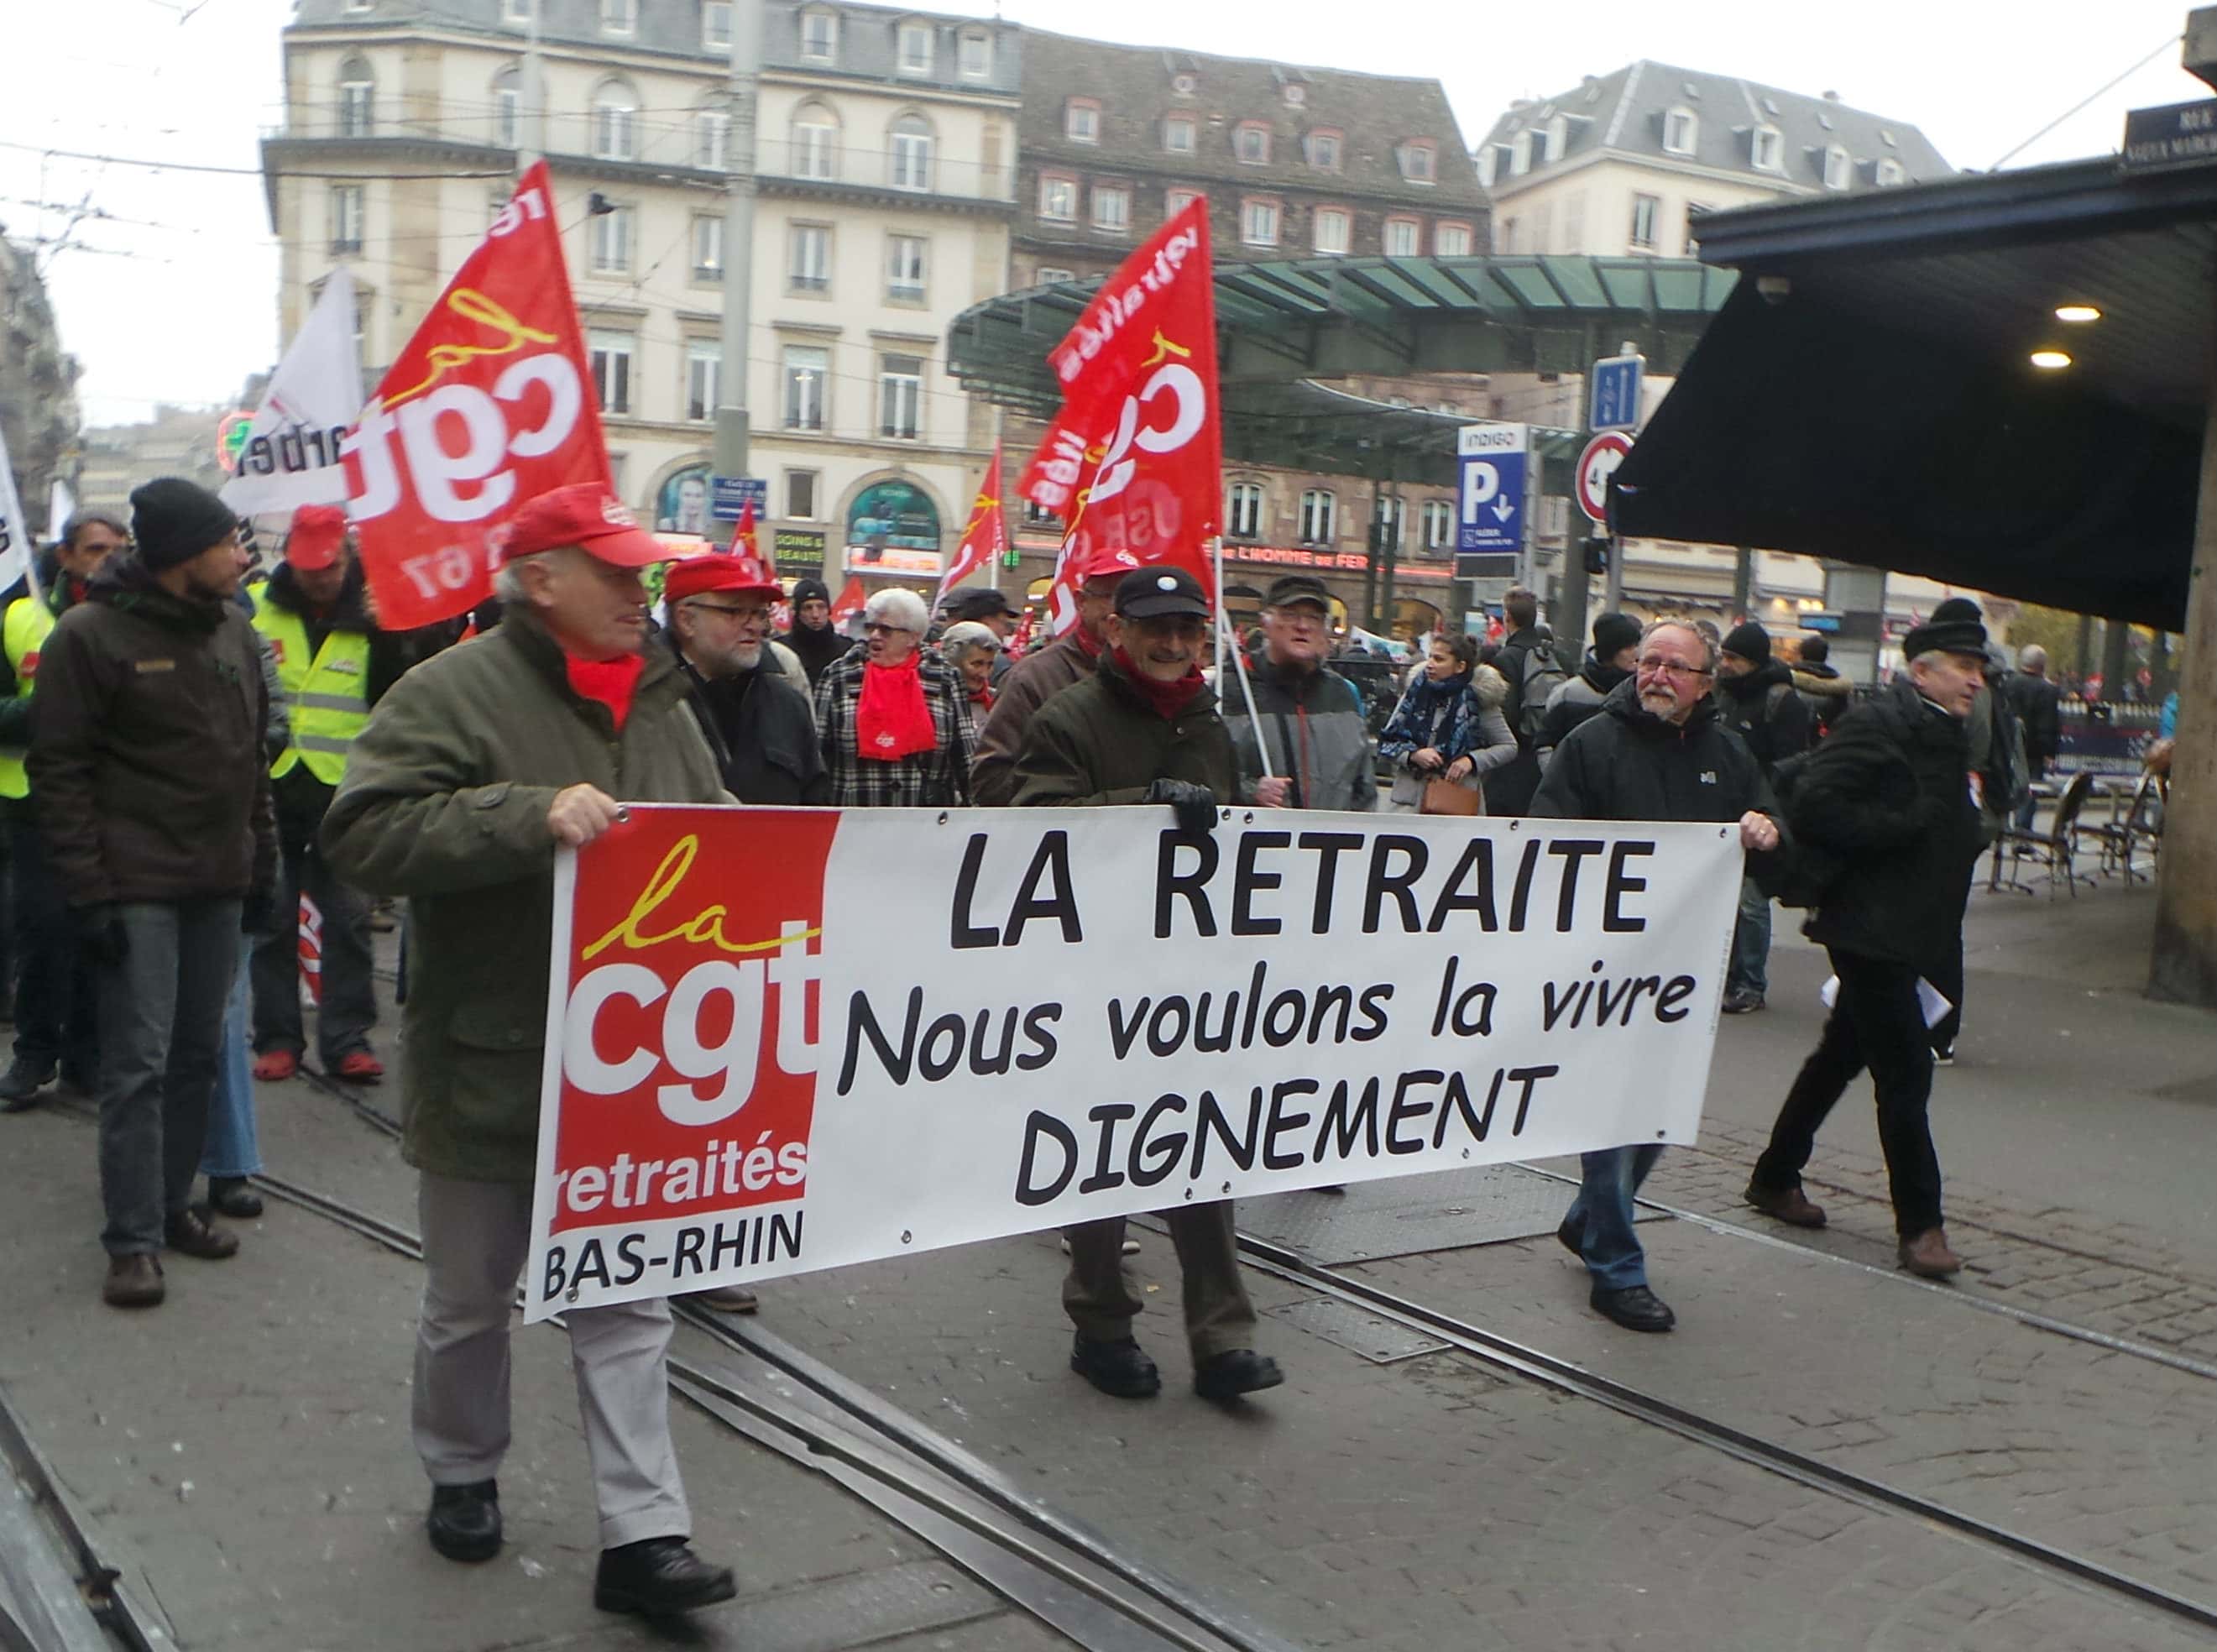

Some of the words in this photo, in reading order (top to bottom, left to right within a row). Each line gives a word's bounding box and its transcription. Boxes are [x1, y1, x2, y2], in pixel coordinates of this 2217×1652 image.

[1462, 462, 1499, 524] P
[1336, 553, 1368, 568] FER
[582, 834, 823, 962] la
[951, 829, 1084, 949] LA
[1153, 829, 1655, 939] RETRAITE
[563, 919, 823, 1127] cgt
[836, 985, 1063, 1096] Nous
[1107, 959, 1394, 1060] voulons
[1430, 954, 1498, 1038] la
[1543, 959, 1697, 1032] vivre
[549, 1129, 809, 1221] retraités
[1015, 1064, 1560, 1206] DIGNEMENT
[542, 1210, 804, 1303] BAS-RHIN
